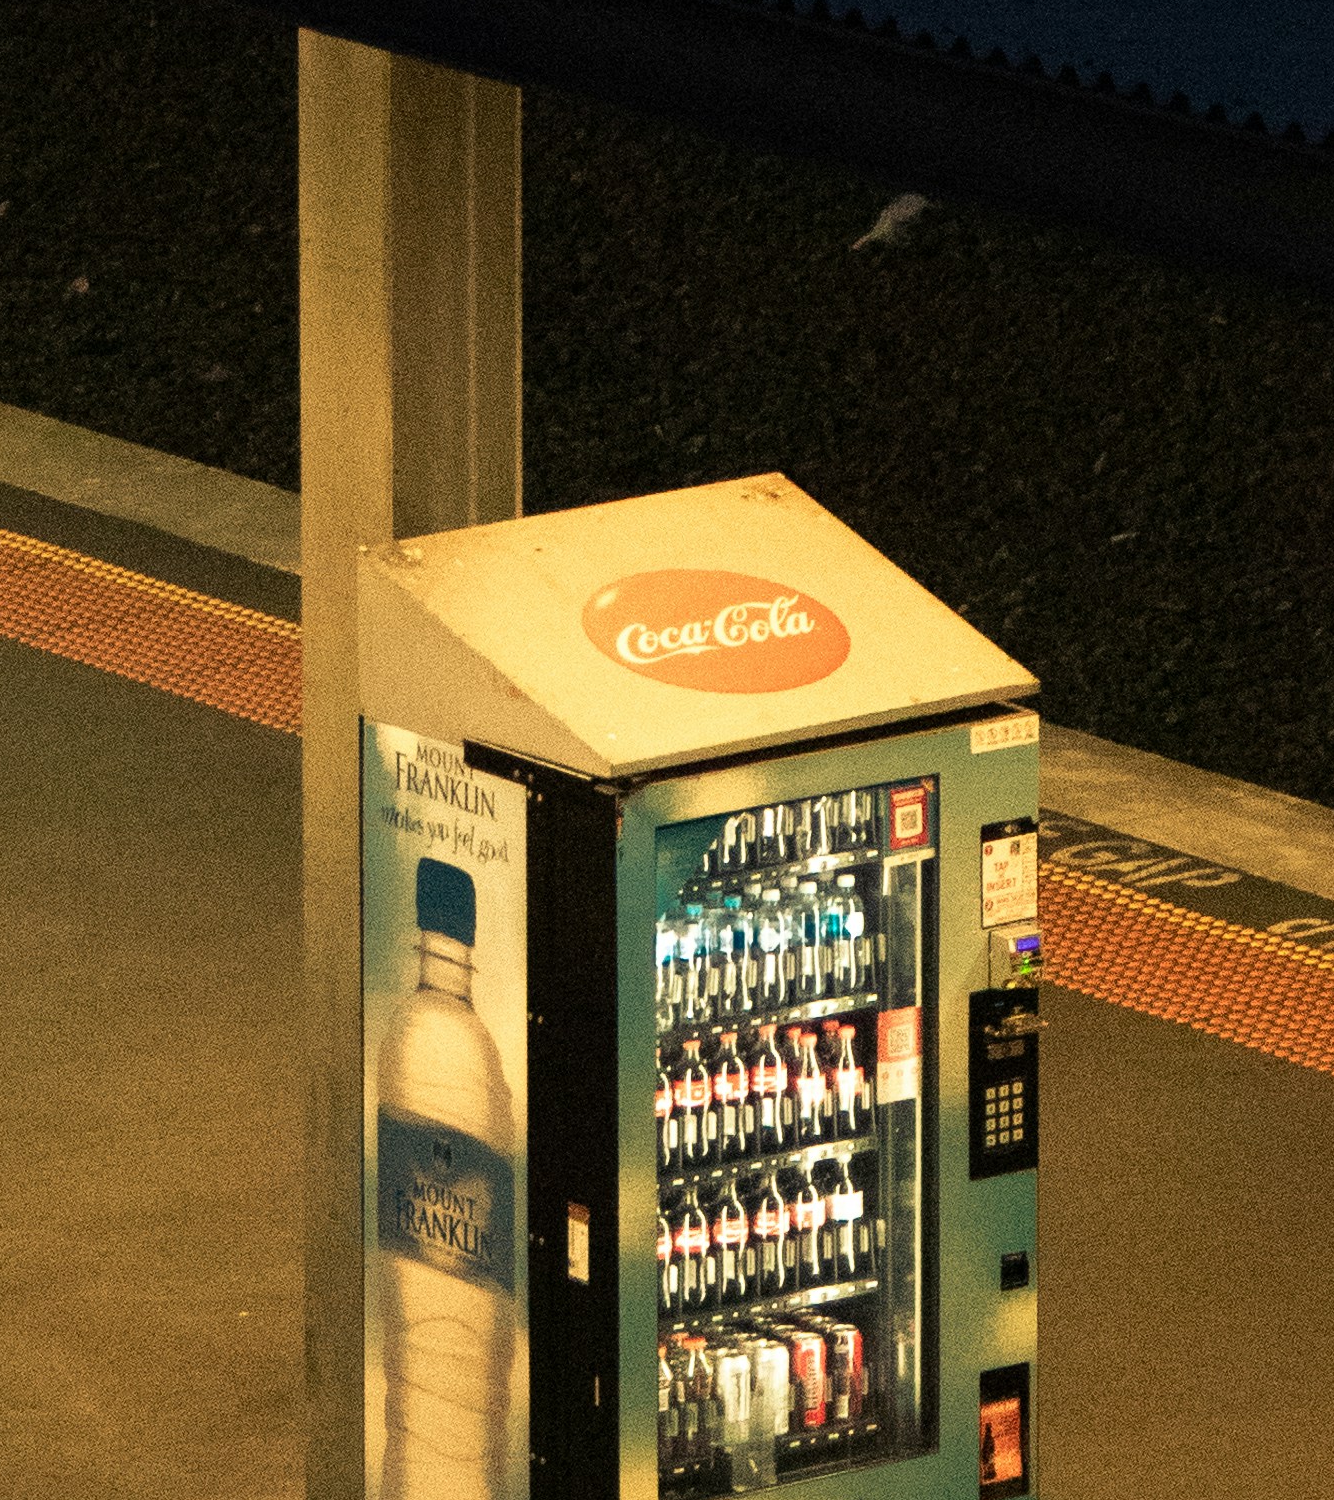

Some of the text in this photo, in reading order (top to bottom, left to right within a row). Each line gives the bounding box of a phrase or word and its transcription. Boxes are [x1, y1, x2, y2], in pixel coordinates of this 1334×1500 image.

[616, 595, 815, 664] Coca-Cola
[395, 751, 496, 822] FRANKLIN
[381, 805, 509, 865] makes you feel good
[1050, 841, 1244, 888] GAP
[993, 861, 1009, 872] TAP
[395, 1188, 493, 1258] FRANKLIN
[412, 1180, 478, 1220] MOUNT
